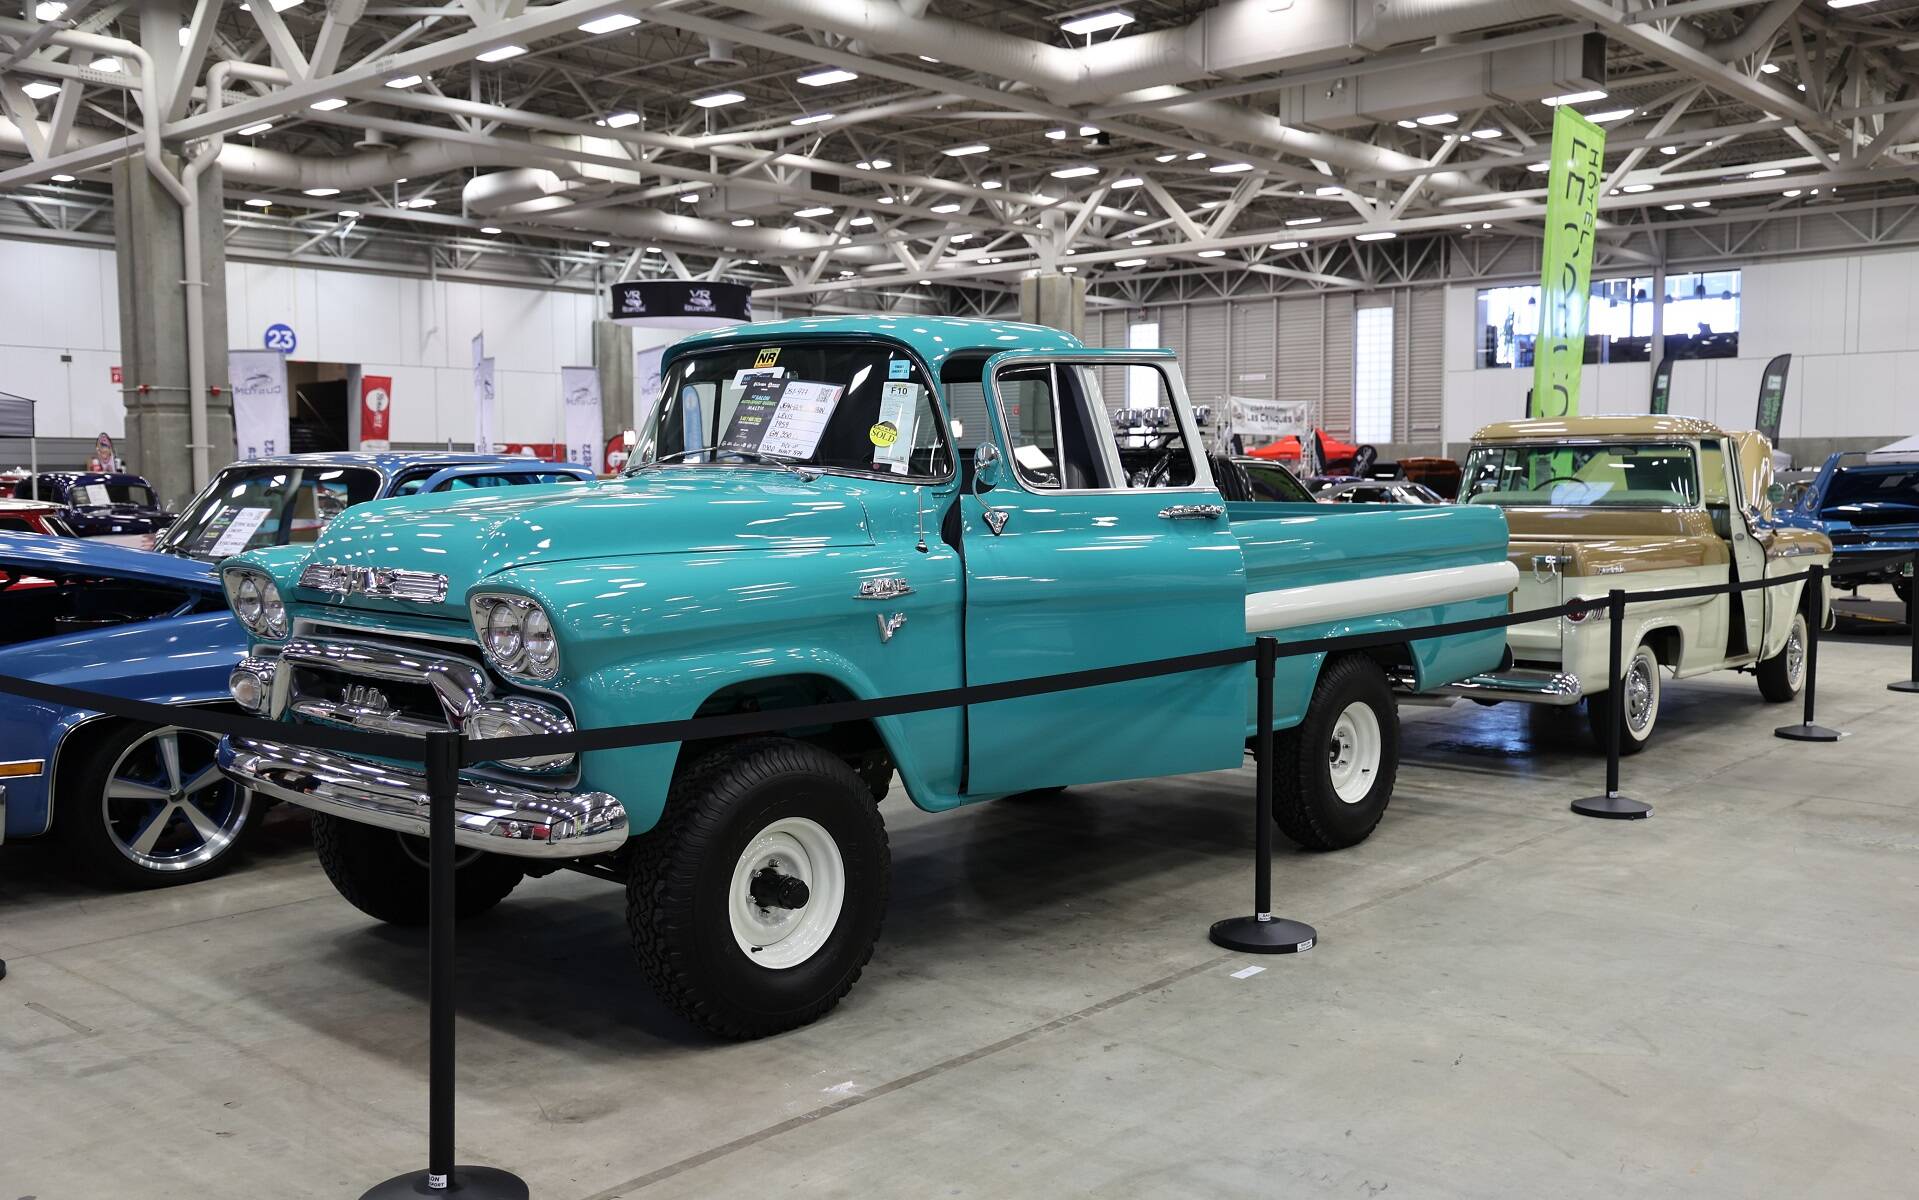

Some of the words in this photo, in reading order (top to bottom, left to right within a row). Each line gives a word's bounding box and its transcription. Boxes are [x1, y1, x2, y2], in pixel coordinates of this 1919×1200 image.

[1565, 136, 1587, 206] LE
[1579, 148, 1600, 244] HÔTEL
[689, 289, 711, 299] VR
[268, 329, 293, 348] 23
[757, 352, 777, 364] NR
[891, 387, 908, 395] F10
[871, 429, 895, 443] SOLD
